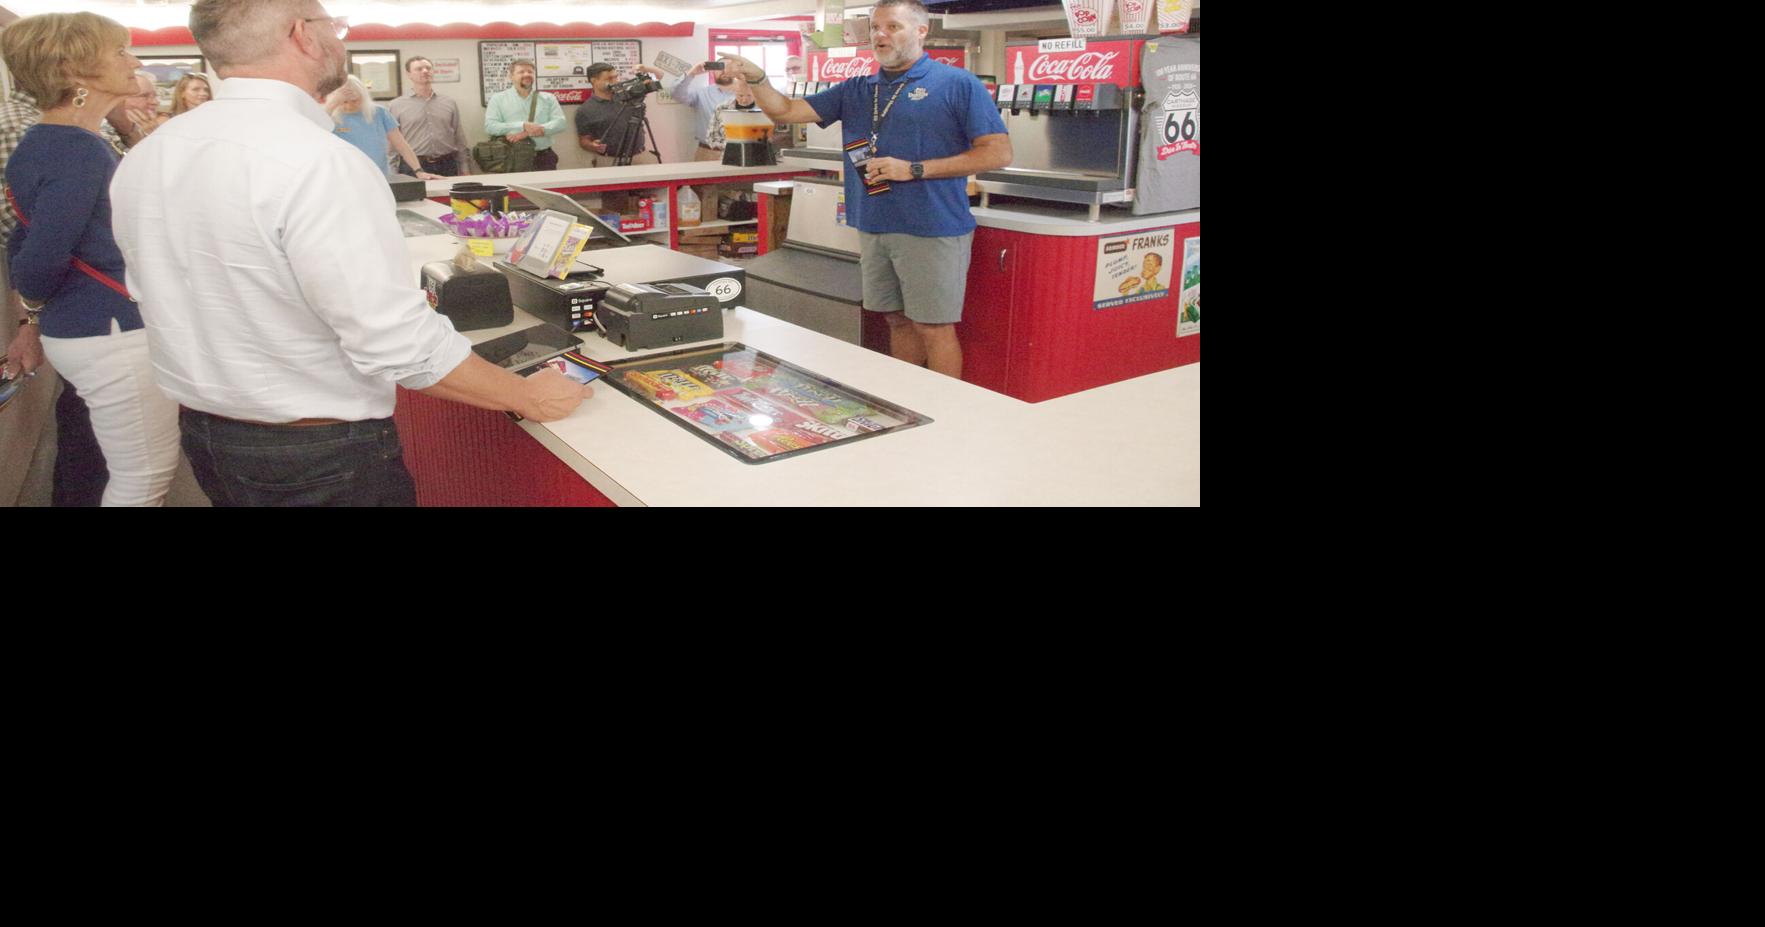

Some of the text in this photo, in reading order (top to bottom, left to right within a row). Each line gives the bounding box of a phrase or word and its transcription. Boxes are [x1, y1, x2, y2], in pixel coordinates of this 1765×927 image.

[1041, 40, 1084, 50] NO REFILL
[821, 57, 874, 78] Coca-Cola
[1028, 51, 1120, 81] Coca-Cola
[1164, 111, 1196, 143] 66
[1132, 234, 1170, 251] FRANKS
[715, 285, 731, 295] 66
